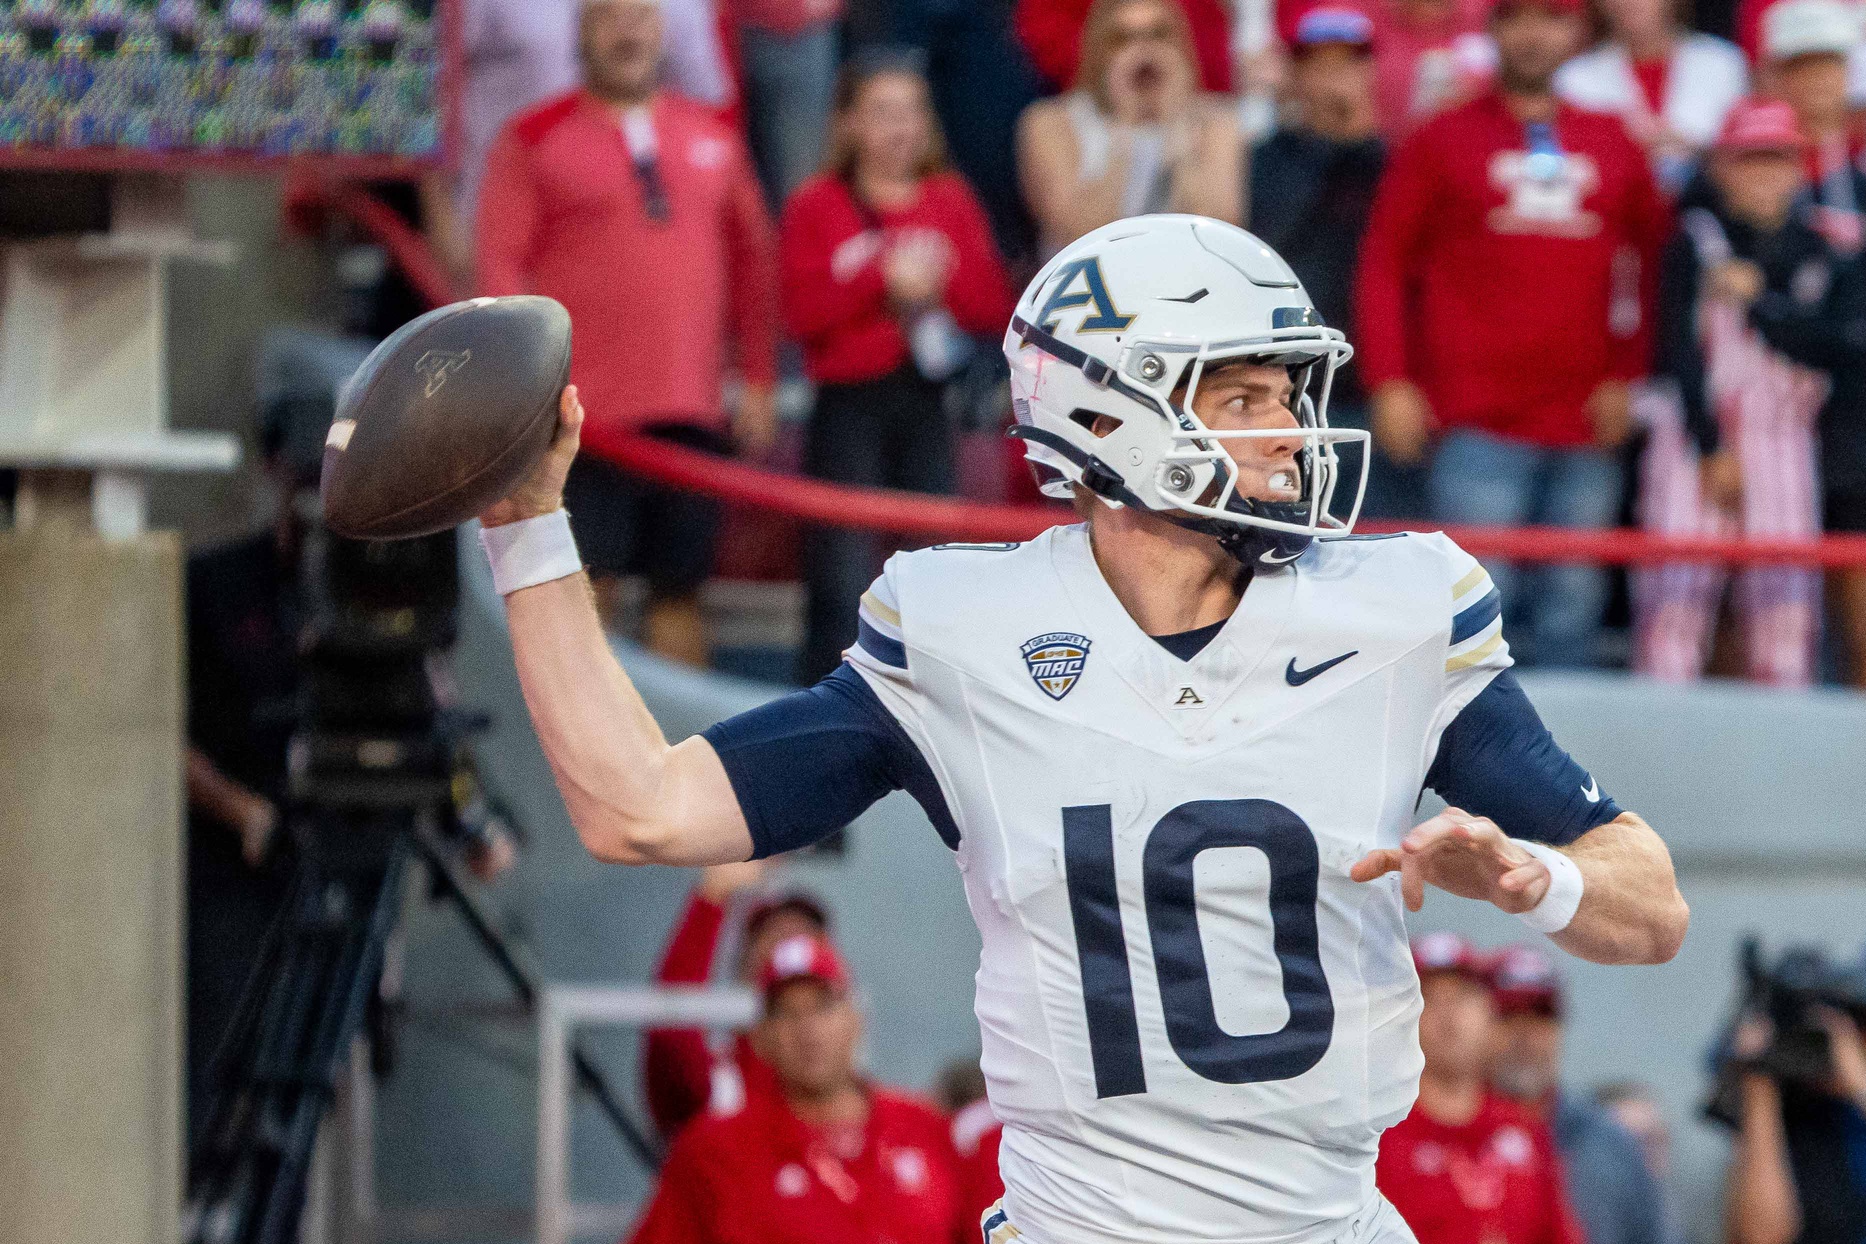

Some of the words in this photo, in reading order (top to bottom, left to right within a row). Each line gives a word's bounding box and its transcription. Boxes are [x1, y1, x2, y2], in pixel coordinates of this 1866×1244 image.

[1019, 255, 1138, 350] A
[1032, 635, 1079, 646] GRADUATE
[1032, 660, 1082, 677] MAC
[1174, 687, 1204, 705] A
[1062, 798, 1335, 1100] 10
